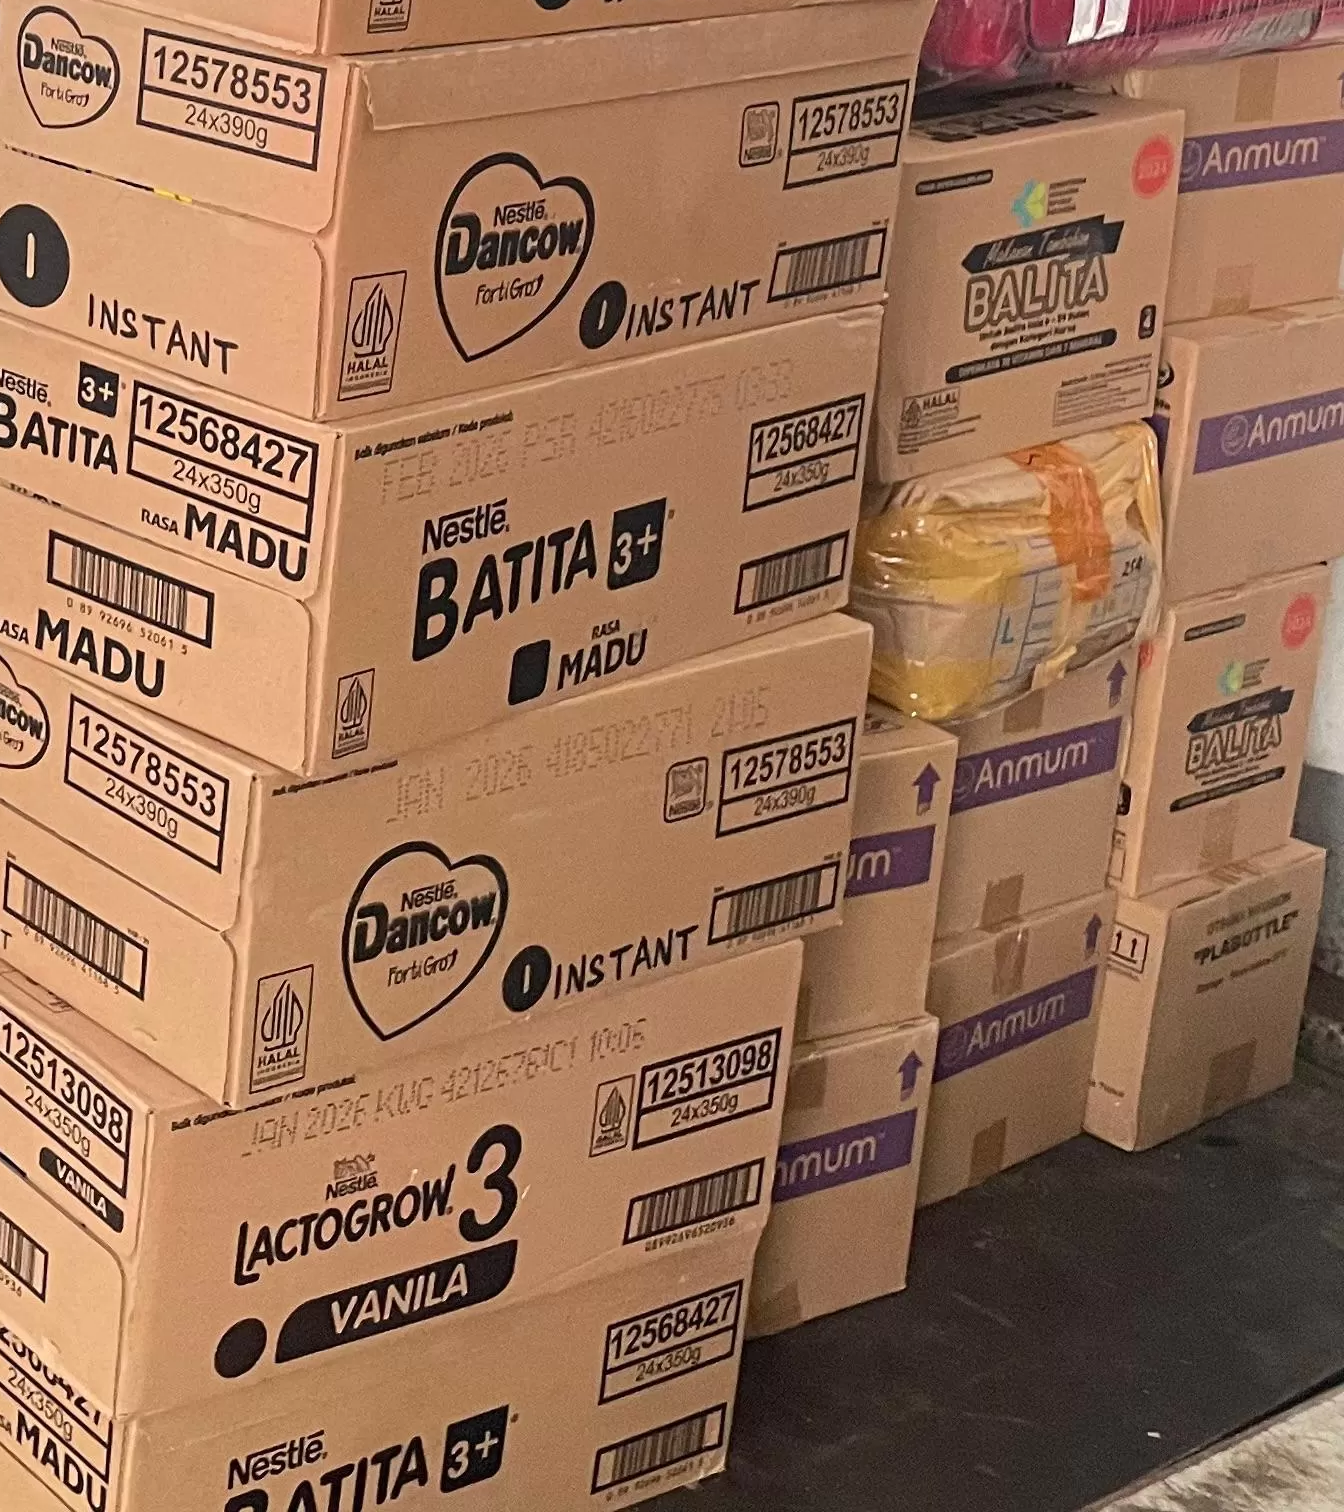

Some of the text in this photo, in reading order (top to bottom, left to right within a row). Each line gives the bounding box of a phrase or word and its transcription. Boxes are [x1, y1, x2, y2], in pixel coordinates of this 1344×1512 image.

[22, 31, 112, 90] Dancow
[153, 44, 313, 116] 12578553
[184, 103, 269, 149] 24x390g
[798, 92, 901, 143] 12578553
[1201, 135, 1319, 177] Anmum
[444, 211, 585, 277] Dancow
[625, 279, 762, 342] INSTANT
[963, 254, 1109, 334] BALITA
[87, 292, 239, 376] INSTANT
[347, 356, 390, 375] HALAL
[79, 375, 115, 404] 3+
[138, 393, 310, 485] 12568427
[752, 415, 860, 466] 12568427
[171, 458, 262, 514] 24x350g
[773, 461, 830, 493] 24x350g
[140, 503, 309, 583] RASA MADU
[412, 518, 659, 662] BATITA 3+
[34, 607, 166, 699] MADU
[557, 627, 649, 691] MADU
[591, 617, 621, 641] RASA
[78, 715, 219, 818] 12578553
[728, 732, 848, 792] 12578553
[974, 738, 1089, 794] Anmum
[1184, 713, 1283, 776] BALITA
[105, 777, 180, 840] 24x390g
[752, 784, 817, 818] 24x390g
[353, 890, 498, 965] Dancow
[552, 925, 699, 1001] INSTANT
[966, 991, 1066, 1056] Anmum
[0, 1019, 125, 1146] 12513098
[256, 1046, 302, 1067] HALAL
[647, 1039, 772, 1105] 12513098
[23, 1084, 93, 1158] 24x350g
[669, 1092, 740, 1129] 24x350g
[55, 1156, 108, 1221] VANILA
[234, 1122, 523, 1287] LACTOGROW 3
[330, 1261, 469, 1337] VANILA
[610, 1288, 739, 1361] 12568427
[635, 1343, 703, 1382] 24x350g
[7, 1366, 74, 1443] 24x350g
[15, 1409, 107, 1512] MADU
[222, 1429, 499, 1512] ATITA 3+
